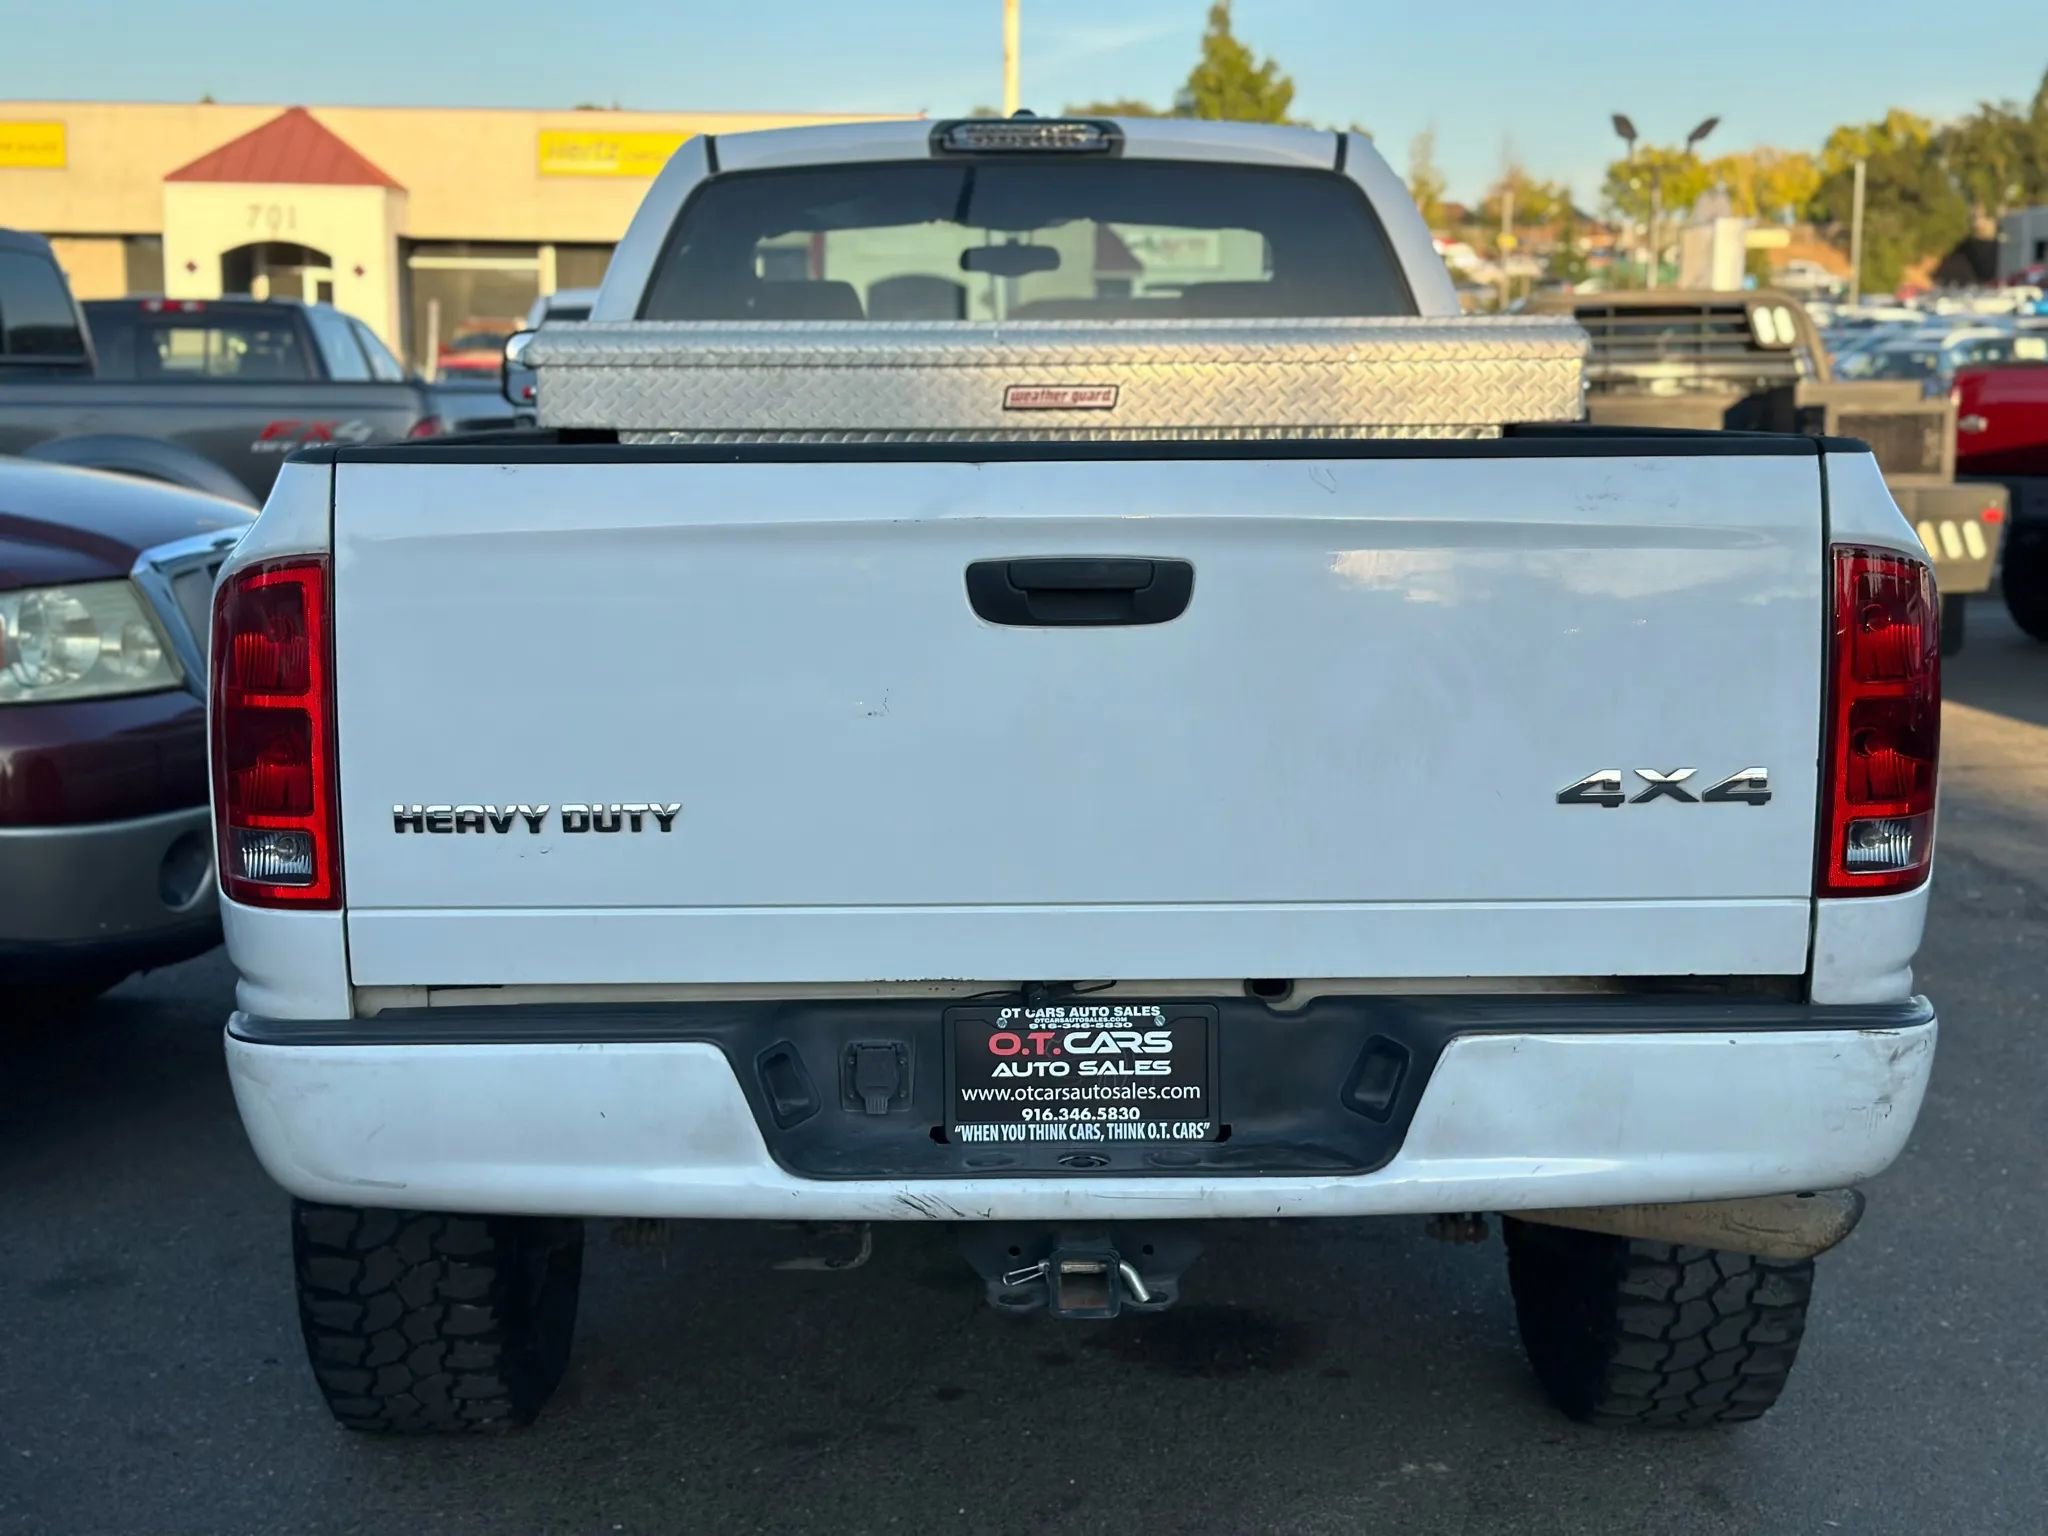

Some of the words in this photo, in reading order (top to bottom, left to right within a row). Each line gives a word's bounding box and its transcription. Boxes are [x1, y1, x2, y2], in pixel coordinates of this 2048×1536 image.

[246, 203, 298, 230] 701
[1010, 388, 1068, 403] weather
[1071, 387, 1111, 404] guard
[260, 420, 373, 442] FX4
[393, 804, 550, 834] HEAVY
[561, 803, 681, 833] DUTY
[1000, 1008, 1021, 1019] OT
[1025, 1007, 1064, 1018] CARS
[1069, 1006, 1110, 1017] AUTO
[1114, 1005, 1161, 1017] SALES
[1028, 1022, 1133, 1030] 916-346-5830
[991, 1062, 1070, 1078] AUTO
[1078, 1060, 1172, 1076] SALES
[961, 1081, 1201, 1101] www.otcarsautosales.com
[1021, 1107, 1141, 1121] 916.346.5830
[1001, 1125, 1027, 1141] YOU
[1028, 1124, 1067, 1141] THINK
[1069, 1124, 1105, 1142] CARS,
[1107, 1123, 1146, 1140] THINK
[1148, 1123, 1171, 1139] O.T.
